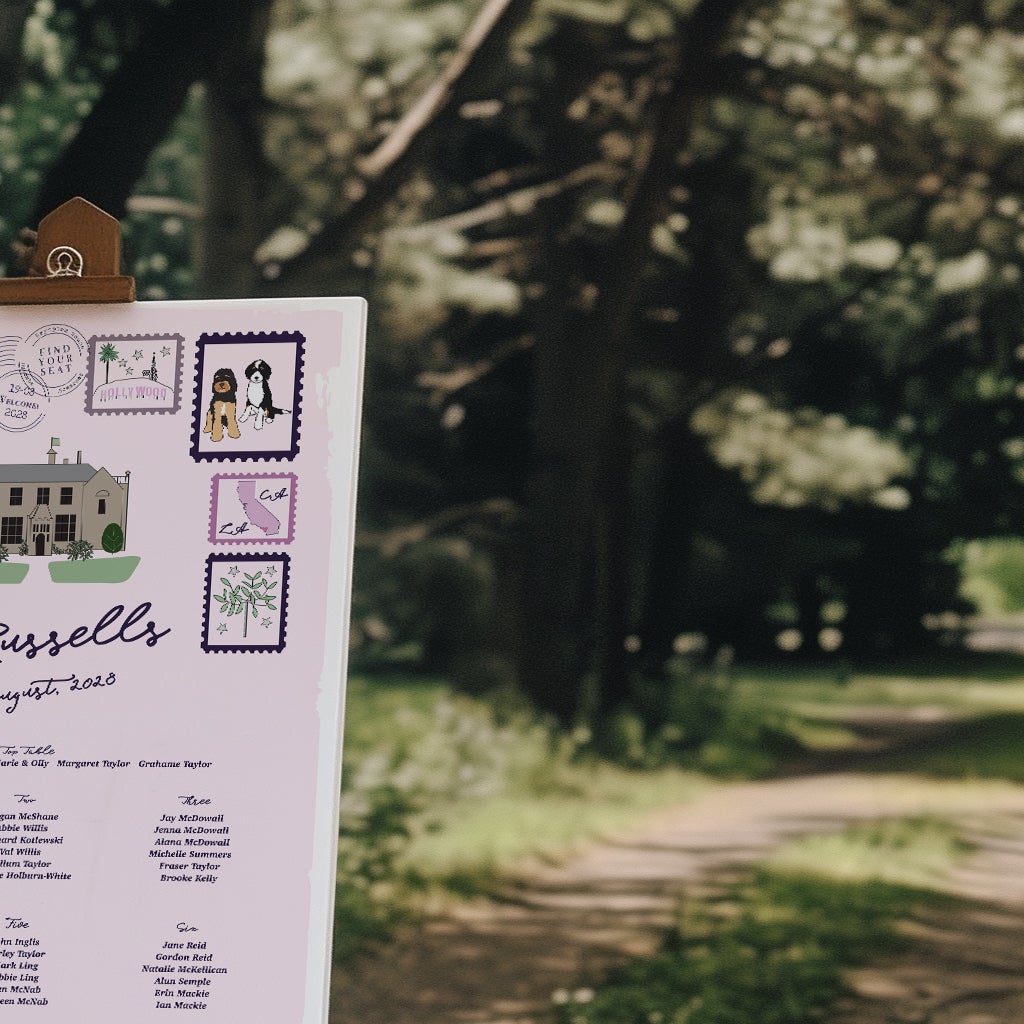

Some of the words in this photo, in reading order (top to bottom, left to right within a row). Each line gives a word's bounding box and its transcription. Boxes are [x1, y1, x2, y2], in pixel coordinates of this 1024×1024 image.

[39, 344, 71, 357] FIND
[38, 354, 73, 366] YOUR
[40, 363, 73, 377] SEAT
[100, 386, 167, 400] HOLLYWOOD
[4, 407, 28, 420] 2028
[259, 487, 289, 502] CA
[218, 521, 250, 536] LA
[70, 672, 117, 691] 2028
[0, 745, 19, 756] Top
[19, 744, 55, 756] Table
[21, 759, 28, 767] &
[30, 759, 50, 769] Olly
[56, 759, 100, 769] Margaret
[101, 759, 131, 770] Taylor
[138, 759, 181, 769] Grahame
[183, 759, 213, 770] Taylor
[13, 794, 37, 804] Two
[177, 795, 212, 806] Three
[18, 812, 59, 821] McShane
[159, 814, 177, 823] Jay
[178, 814, 224, 822] McDowall
[23, 824, 49, 832] Willis
[153, 826, 182, 834] Jenna
[183, 826, 230, 835] McDowall
[19, 836, 64, 845] Kotlewski
[154, 837, 182, 846] Alana
[184, 838, 230, 847] McDowall
[0, 847, 14, 856] Val
[16, 848, 42, 856] Willis
[148, 849, 187, 858] Michelle
[188, 850, 232, 859] Summers
[23, 860, 52, 869] Taylor
[159, 862, 189, 870] Fraser
[190, 862, 221, 872] Taylor
[5, 871, 72, 880] Holburn-White
[160, 874, 193, 882] Brooke
[194, 874, 218, 884] Kelly
[4, 917, 30, 929] Five
[176, 922, 199, 933] Six
[14, 937, 40, 947] Inglis
[162, 941, 184, 949] Jane
[186, 941, 207, 950] Reid
[16, 950, 46, 959] Taylor
[155, 953, 190, 961] Gordon
[191, 953, 213, 962] Reid
[18, 961, 39, 971] Ling
[141, 964, 176, 973] Natalie
[19, 973, 40, 983] Ling
[154, 977, 176, 985] Alun
[178, 977, 212, 987] Semple
[9, 985, 42, 994] McNab
[154, 989, 174, 997] Erin
[176, 989, 210, 998] Mackie
[16, 997, 49, 1006] McNab
[155, 1001, 172, 1009] Ian
[173, 1001, 207, 1010] Mackie
